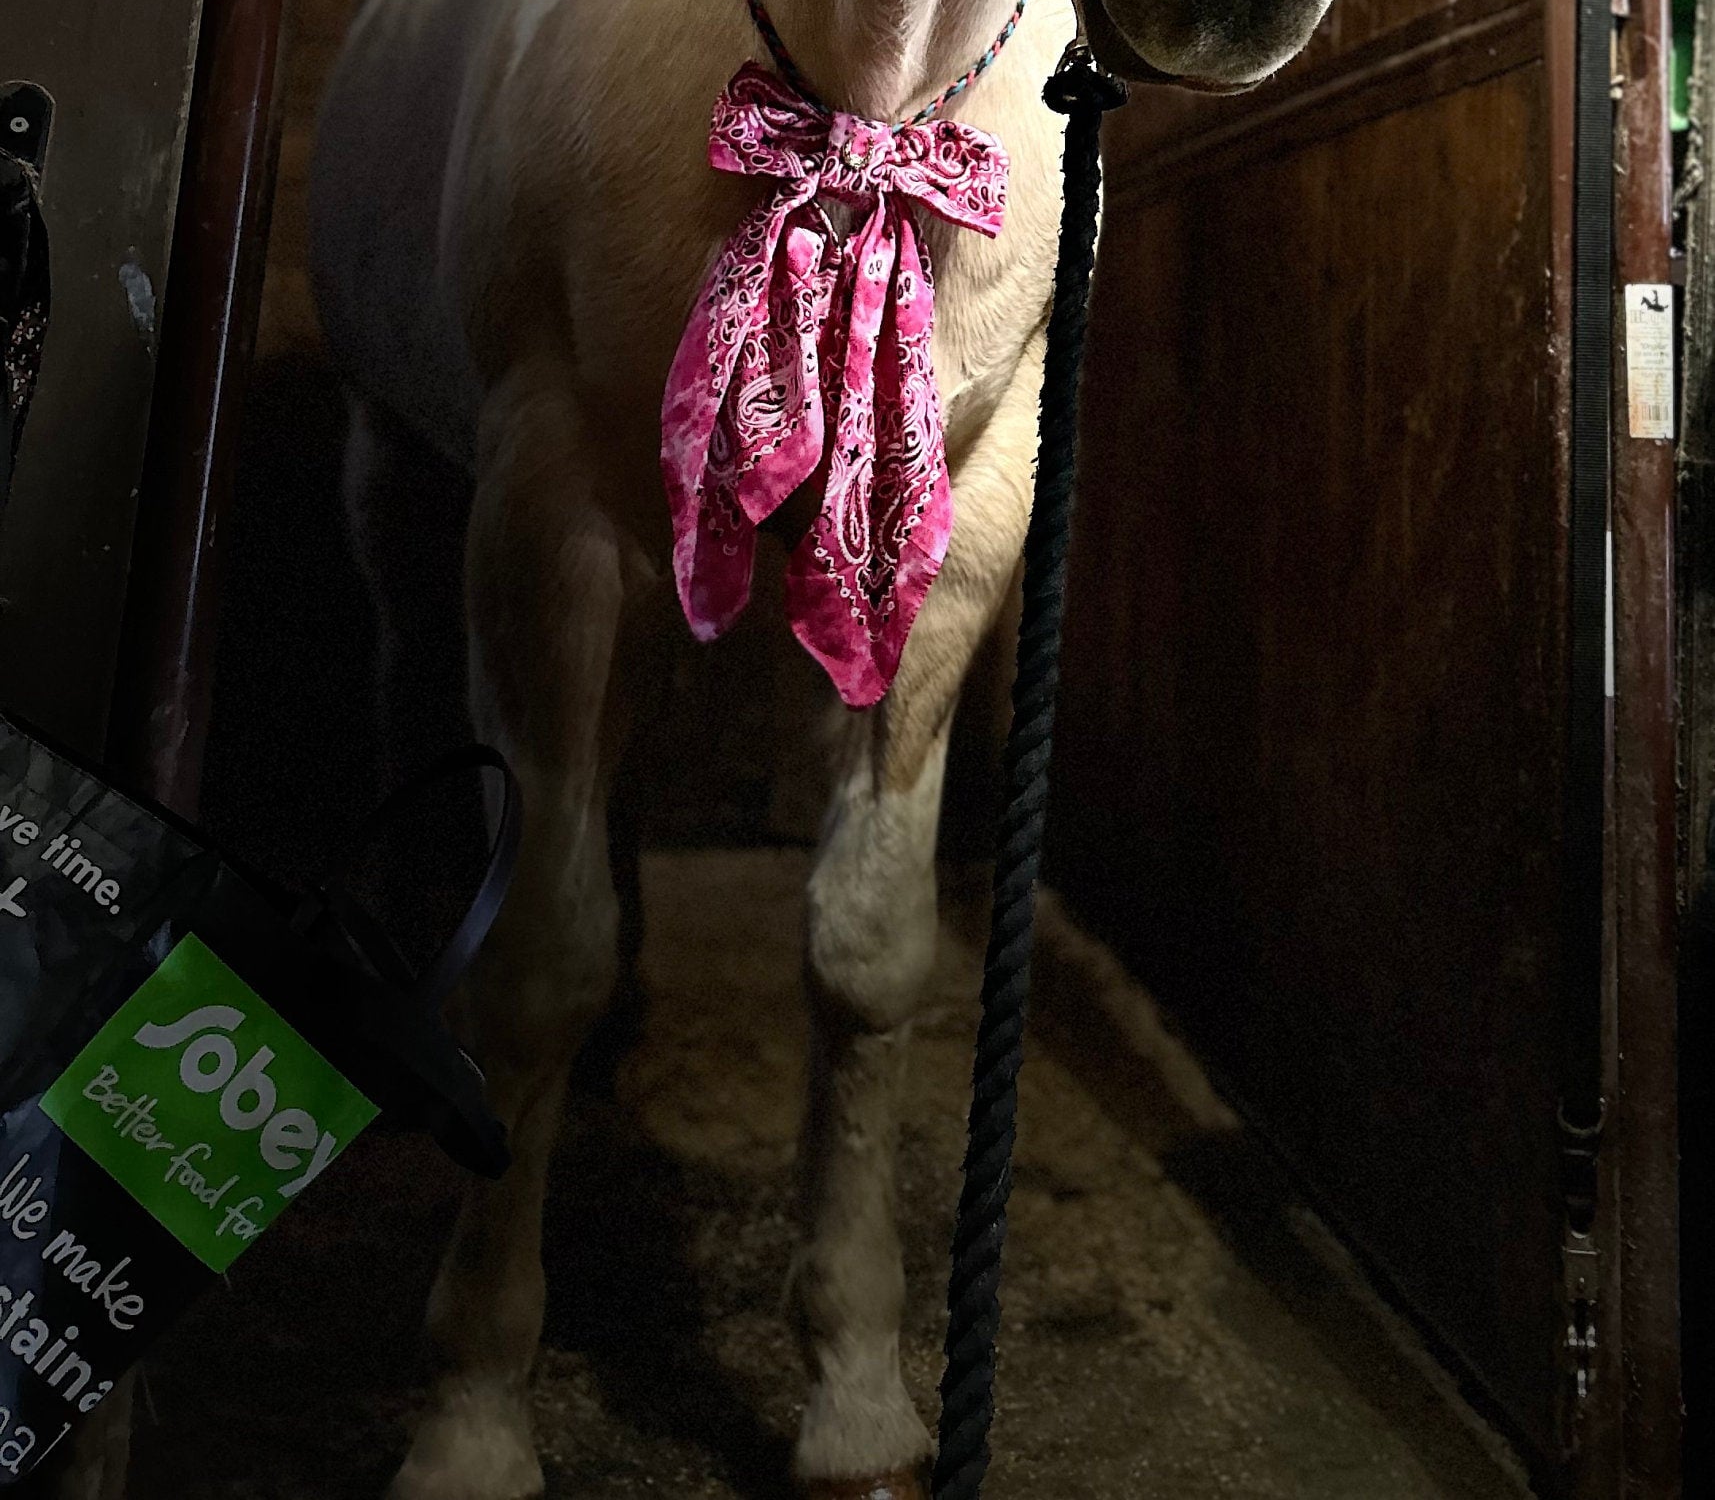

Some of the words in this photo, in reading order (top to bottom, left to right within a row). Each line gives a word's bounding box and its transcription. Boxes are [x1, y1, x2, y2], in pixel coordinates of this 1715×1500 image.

[40, 833, 121, 915] time.
[82, 1063, 176, 1151] Better
[163, 1143, 241, 1210] food
[0, 1153, 49, 1240] We
[41, 1228, 145, 1331] make
